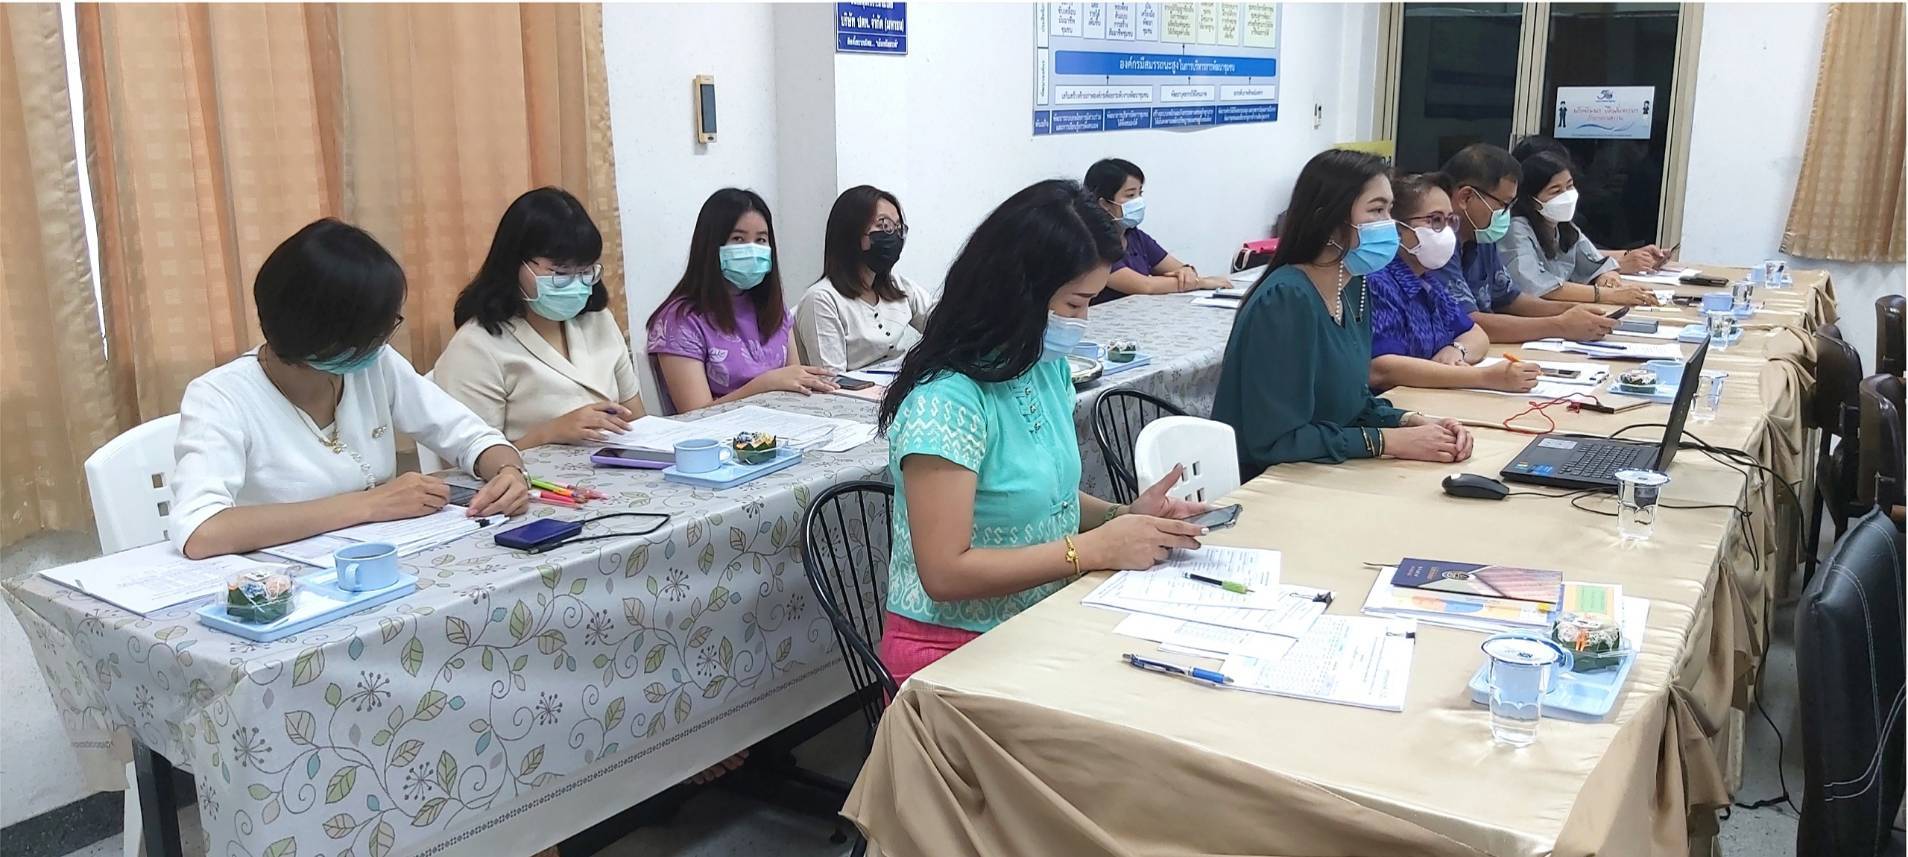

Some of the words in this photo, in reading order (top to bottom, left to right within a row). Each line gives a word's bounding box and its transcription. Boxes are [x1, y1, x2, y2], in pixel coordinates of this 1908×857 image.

[841, 11, 856, 27] บริษัท
[857, 15, 870, 29] ปตท.
[871, 13, 883, 30] จำกัด
[884, 17, 904, 32] (มหาชน)
